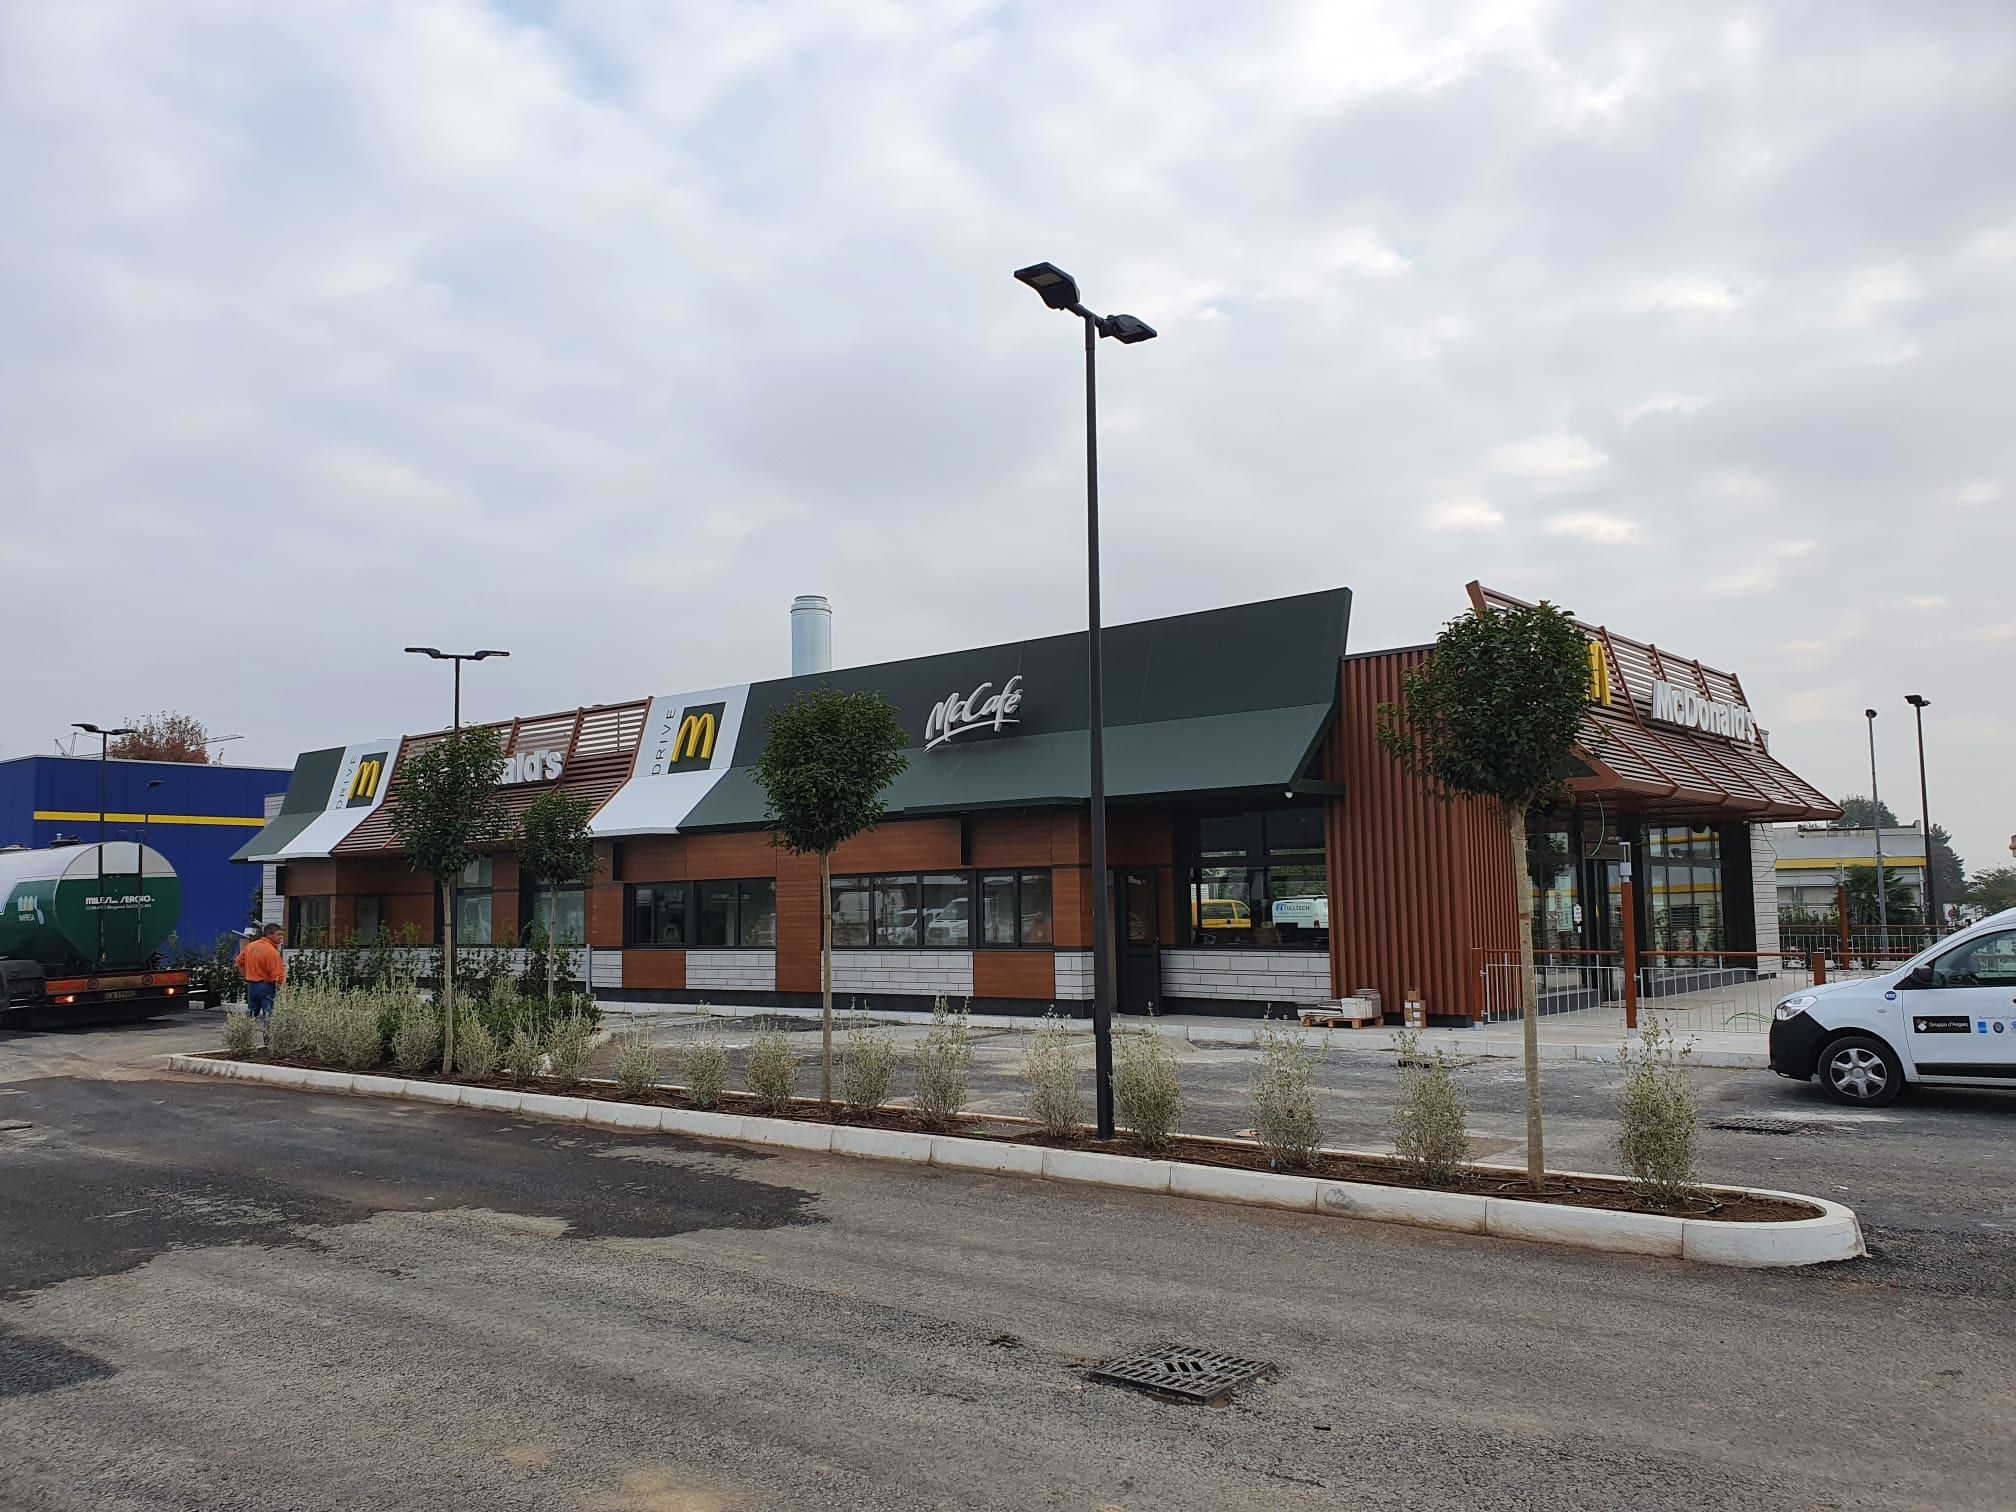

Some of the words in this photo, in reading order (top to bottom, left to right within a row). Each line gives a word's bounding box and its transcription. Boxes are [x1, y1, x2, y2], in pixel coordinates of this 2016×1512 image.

[651, 708, 676, 775] DRIVE
[1652, 679, 1756, 743] McDonald's
[335, 755, 357, 809] DRIVE
